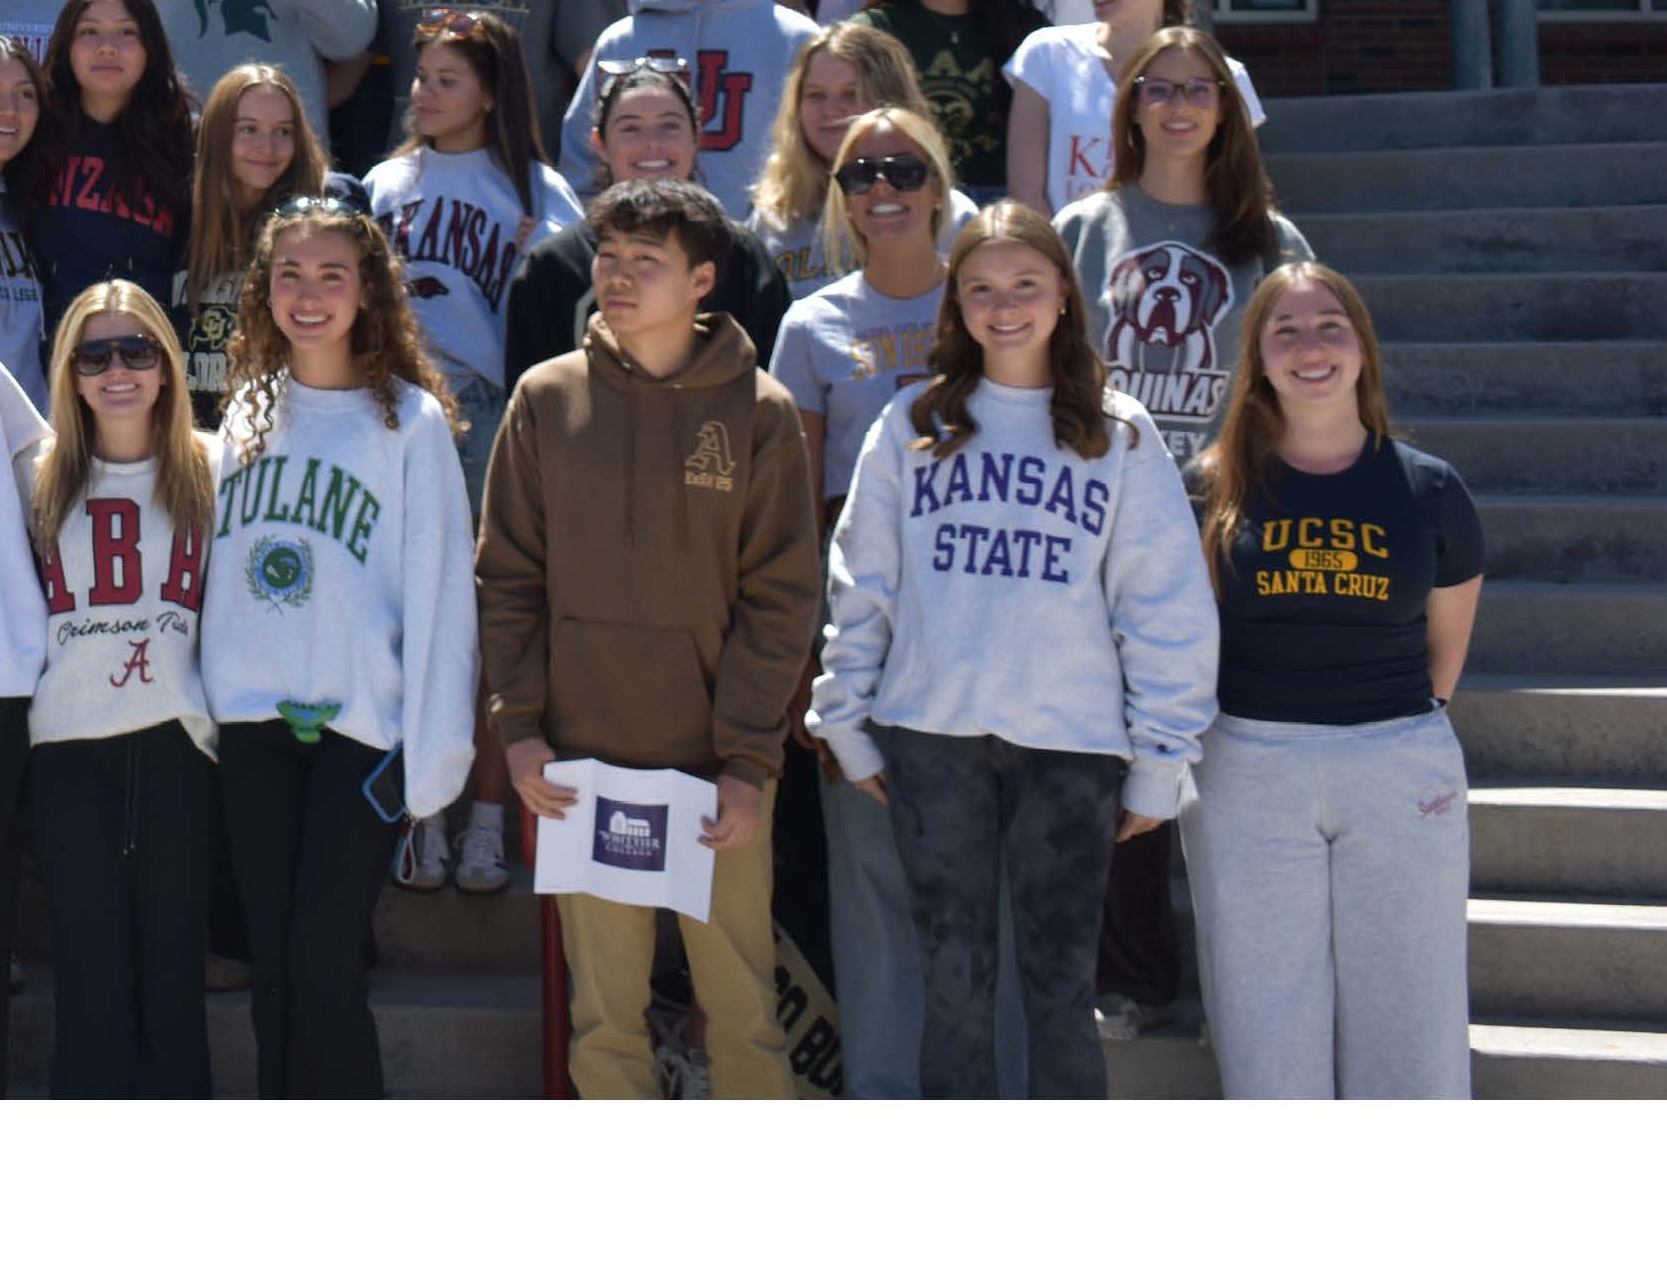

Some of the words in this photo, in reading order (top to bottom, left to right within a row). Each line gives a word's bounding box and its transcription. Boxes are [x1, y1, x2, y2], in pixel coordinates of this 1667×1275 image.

[215, 456, 381, 566] TULANE
[910, 452, 1111, 537] KANSAS
[932, 524, 1072, 586] STATE
[1261, 517, 1390, 560] UCSC
[1304, 550, 1344, 570] 1965
[1256, 570, 1328, 597] SANTA
[1333, 572, 1390, 602] CRUZ
[57, 618, 150, 646] Crimson
